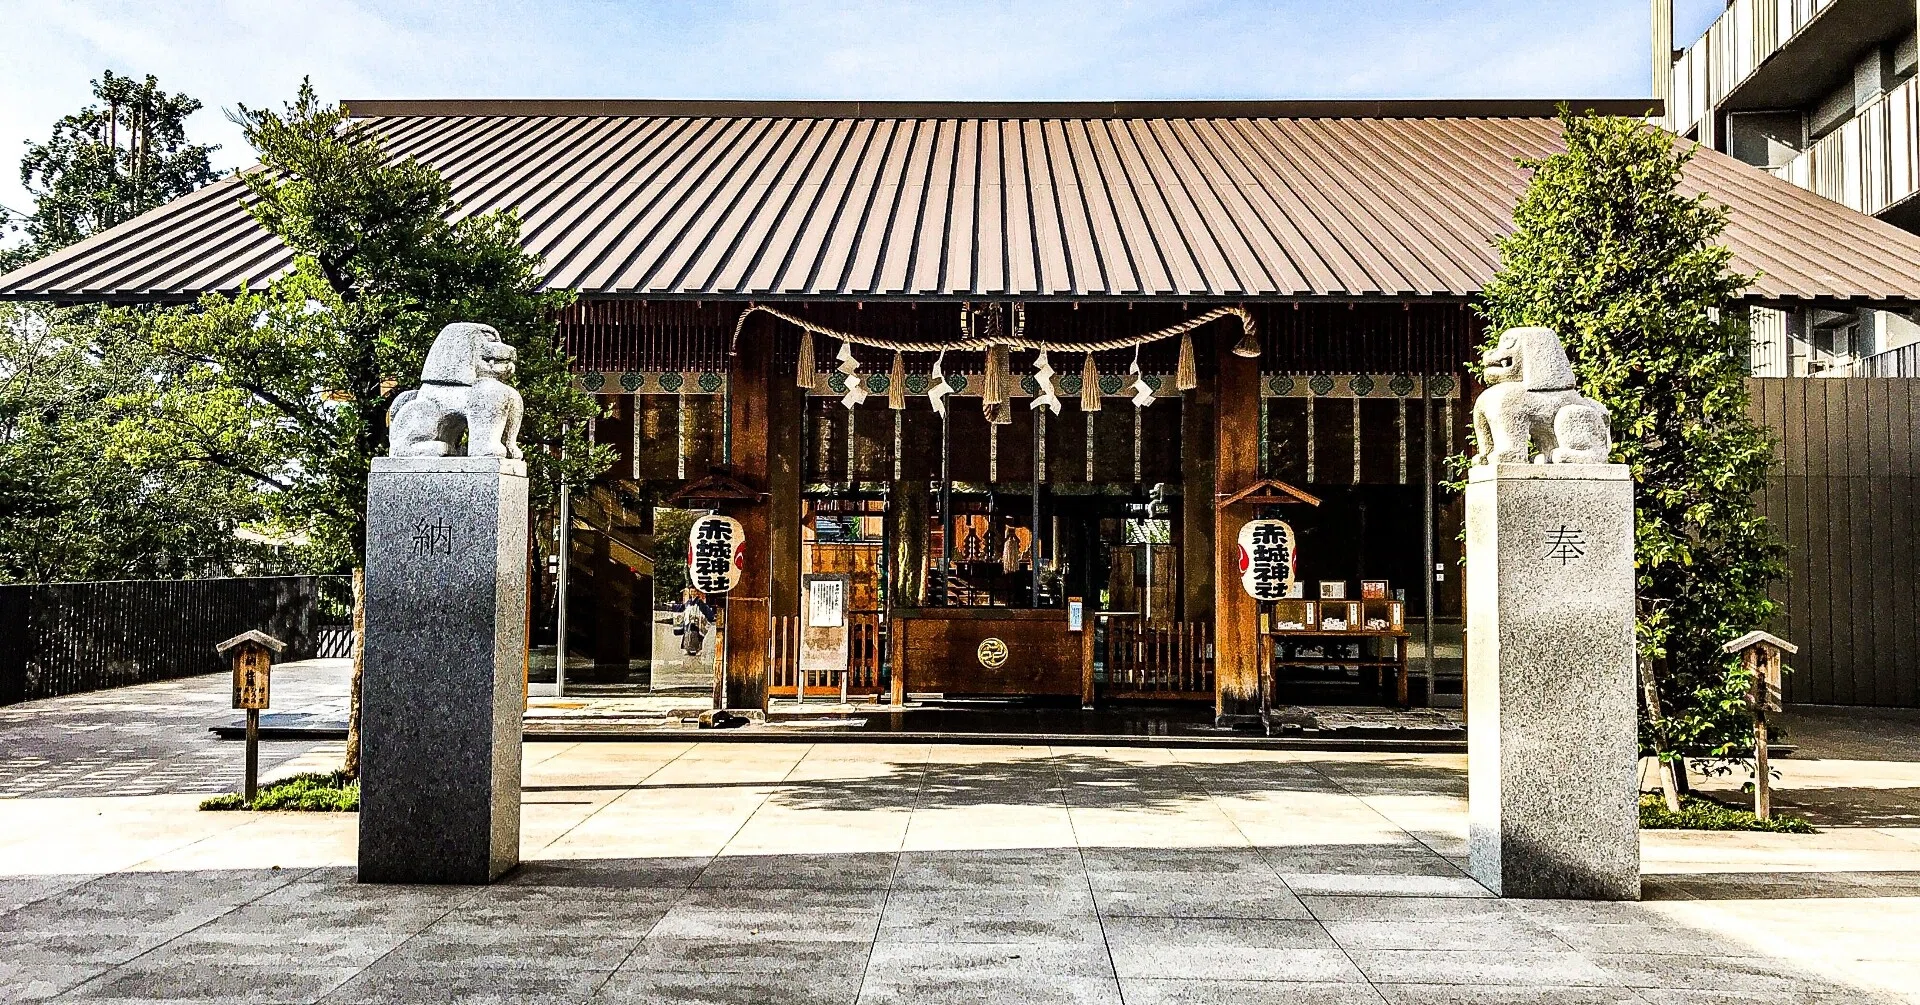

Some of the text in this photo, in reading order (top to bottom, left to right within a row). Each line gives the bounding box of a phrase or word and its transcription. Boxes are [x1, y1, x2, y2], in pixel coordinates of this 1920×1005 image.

[412, 517, 452, 557] 納
[696, 519, 733, 592] 赤城神社
[1252, 523, 1290, 599] 赤城神社
[1543, 524, 1587, 566] 奉
